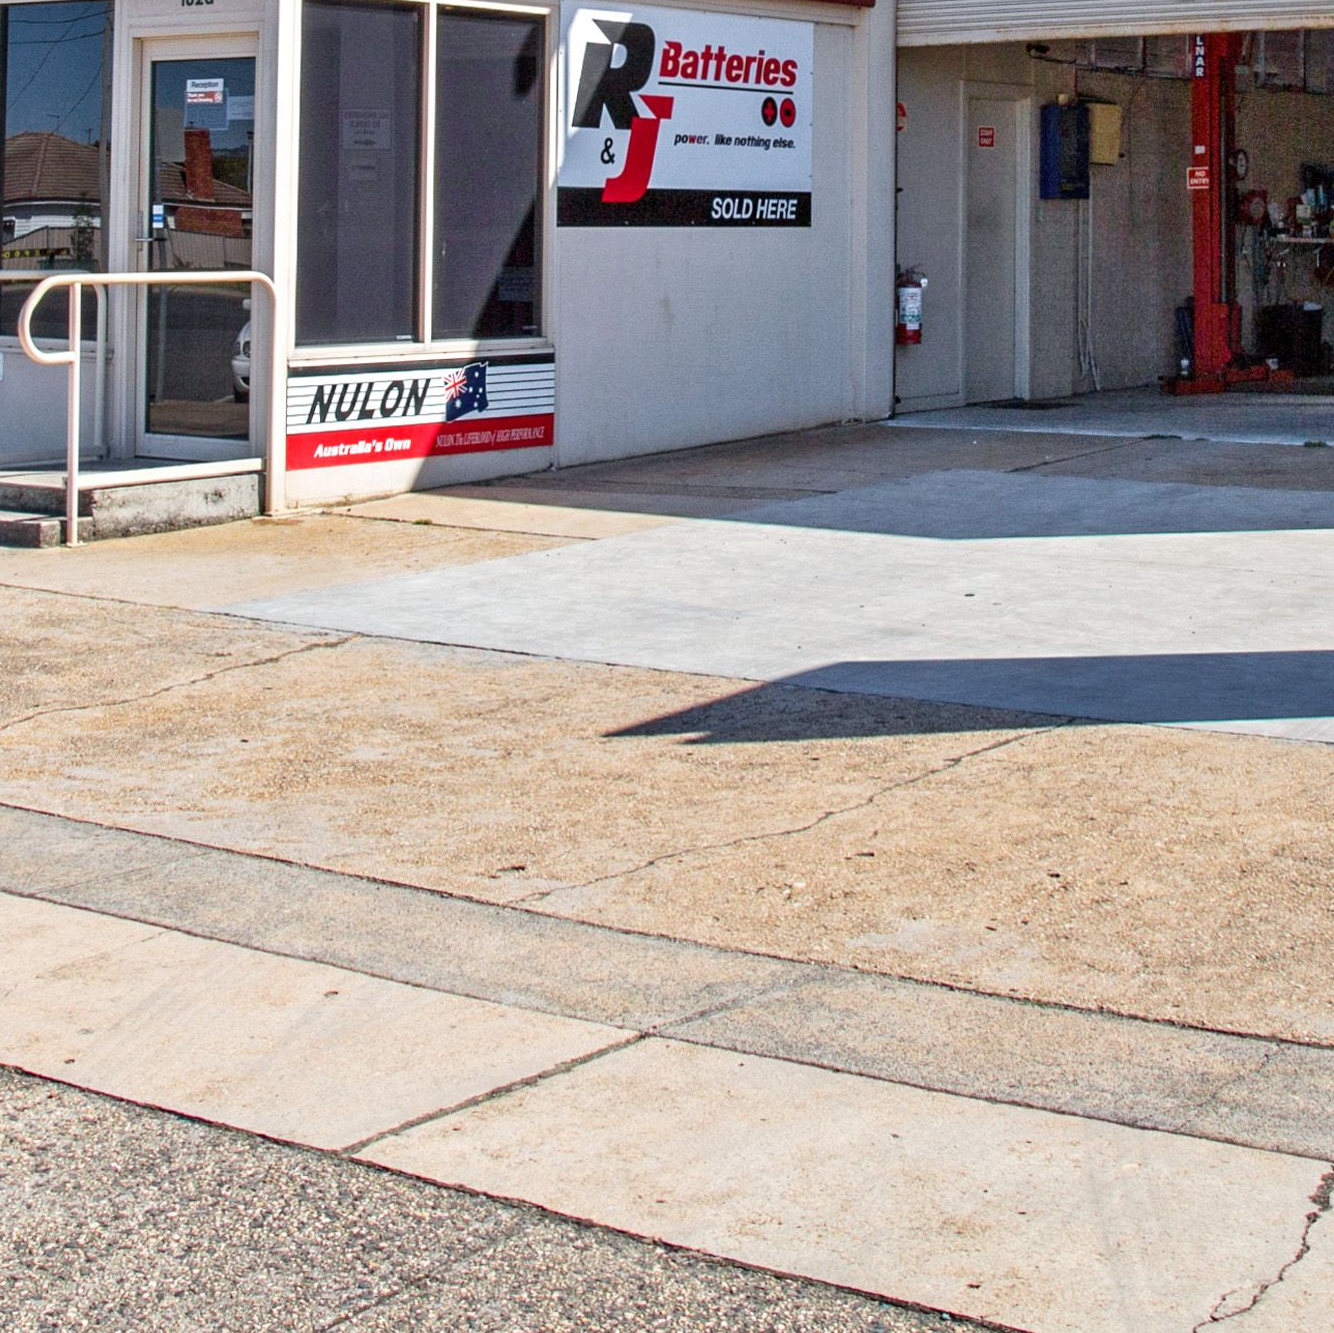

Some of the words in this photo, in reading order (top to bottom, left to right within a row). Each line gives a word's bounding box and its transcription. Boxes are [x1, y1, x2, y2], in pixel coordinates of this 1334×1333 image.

[659, 40, 798, 87] Batteries
[191, 80, 219, 89] Reception
[600, 137, 615, 164] &
[674, 134, 709, 146] power.
[715, 134, 732, 146] like
[734, 136, 771, 151] nothing
[772, 137, 796, 149] else.
[711, 197, 753, 219] SOLD
[755, 198, 798, 219] HERE
[306, 378, 431, 424] NULON
[313, 439, 383, 458] Australia's
[384, 438, 411, 452] Own
